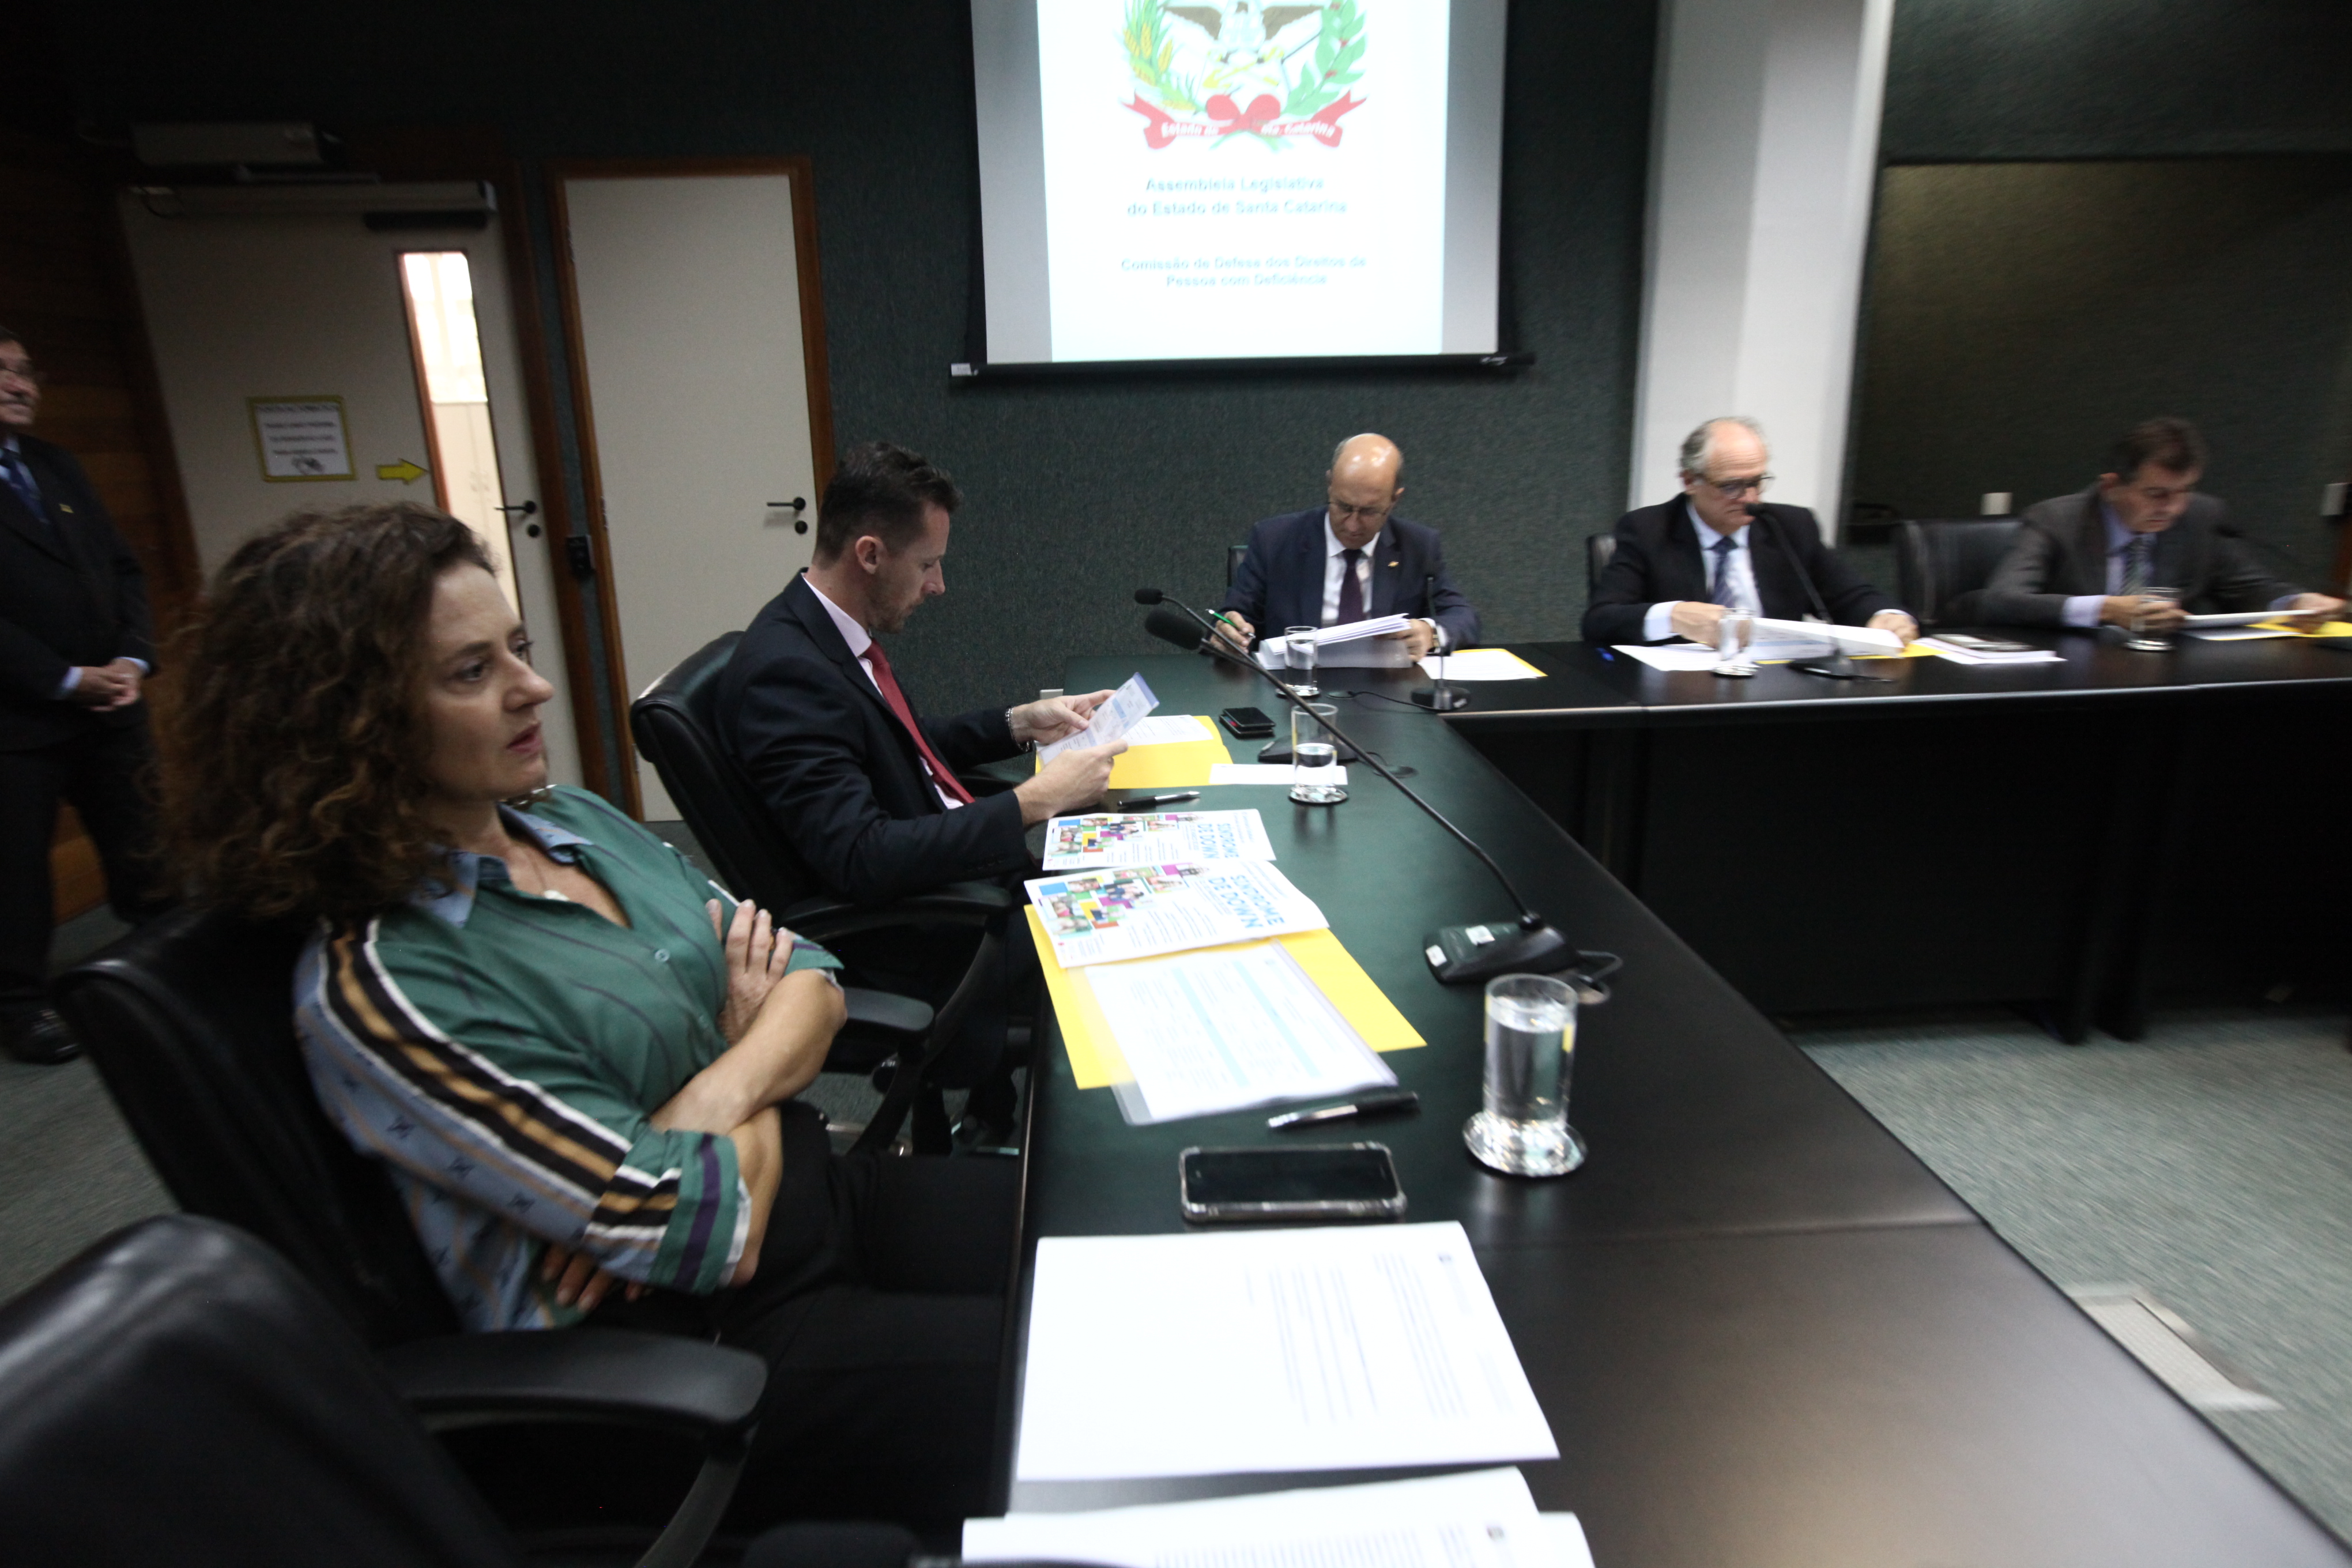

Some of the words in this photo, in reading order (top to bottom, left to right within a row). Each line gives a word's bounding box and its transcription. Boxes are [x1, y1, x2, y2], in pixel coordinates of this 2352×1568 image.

[1145, 177, 1235, 191] Assembleia
[1241, 176, 1324, 193] Legislativa
[1127, 202, 1147, 216] do
[1152, 201, 1205, 215] Estado
[1211, 201, 1230, 214] de
[1236, 199, 1278, 214] Santa
[1284, 199, 1347, 213] Catarina
[1121, 257, 1189, 270] Comissão
[1193, 257, 1209, 269] de
[1215, 257, 1261, 269] Defesa
[1265, 256, 1290, 267] dos
[1295, 255, 1345, 267] Direitos
[1167, 274, 1216, 287] Pessoa
[1221, 276, 1250, 285] com
[1254, 273, 1327, 285] Deficiência
